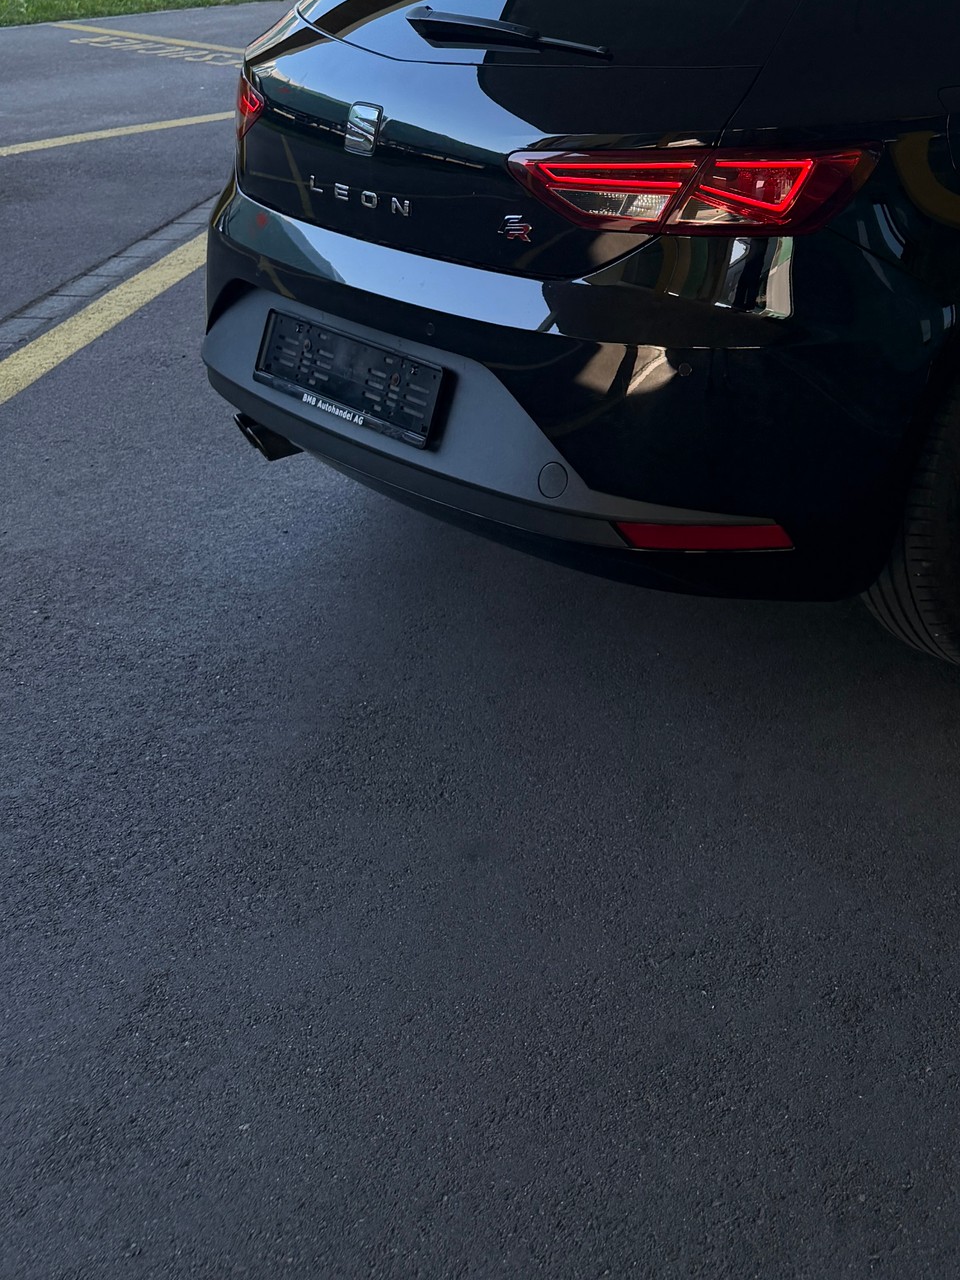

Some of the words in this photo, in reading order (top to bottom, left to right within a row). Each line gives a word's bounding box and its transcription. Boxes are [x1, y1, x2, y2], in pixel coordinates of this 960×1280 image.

[309, 175, 412, 217] LEON
[302, 393, 317, 406] BMB
[317, 399, 354, 421] Autohandel
[353, 414, 364, 425] AG
